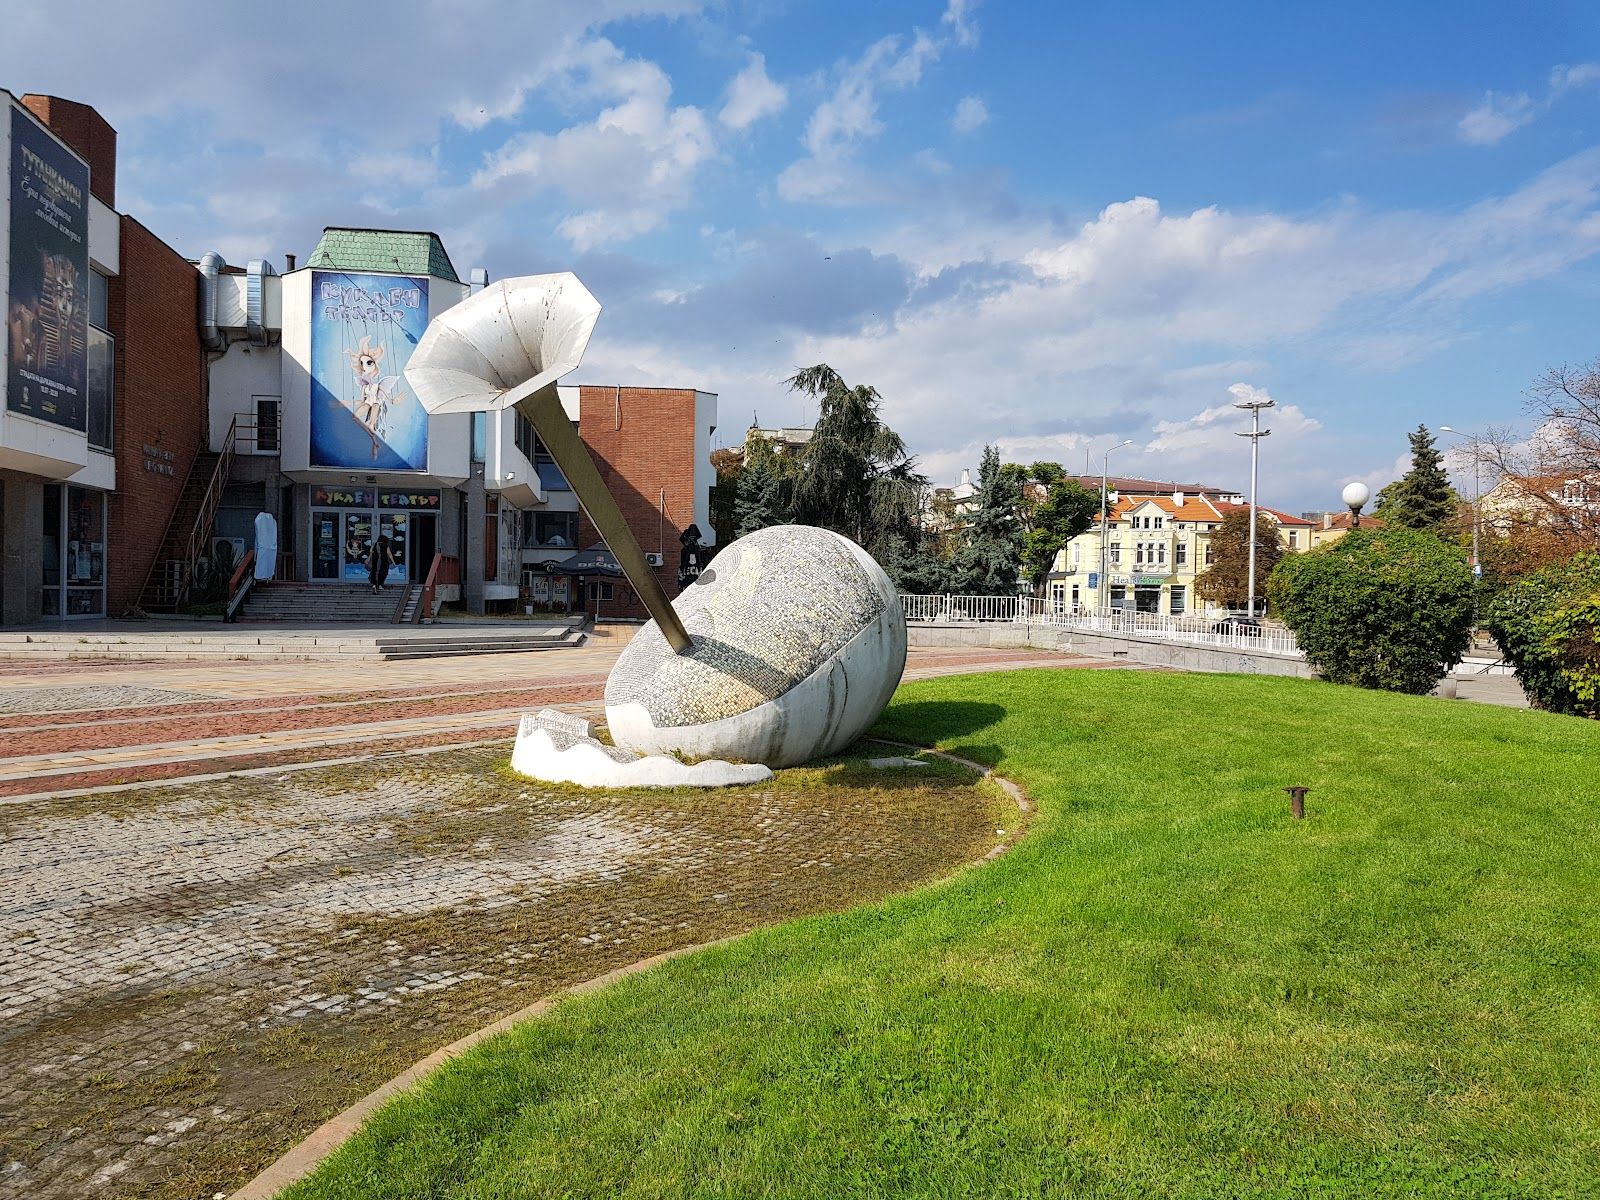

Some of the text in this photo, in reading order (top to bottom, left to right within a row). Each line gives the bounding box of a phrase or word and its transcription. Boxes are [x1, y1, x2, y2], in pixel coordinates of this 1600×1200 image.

[321, 281, 419, 308] КУКЛЕН
[325, 304, 404, 322] ТЕАТЪР
[316, 490, 438, 507] КУКЛЕН ТЕАТЪР
